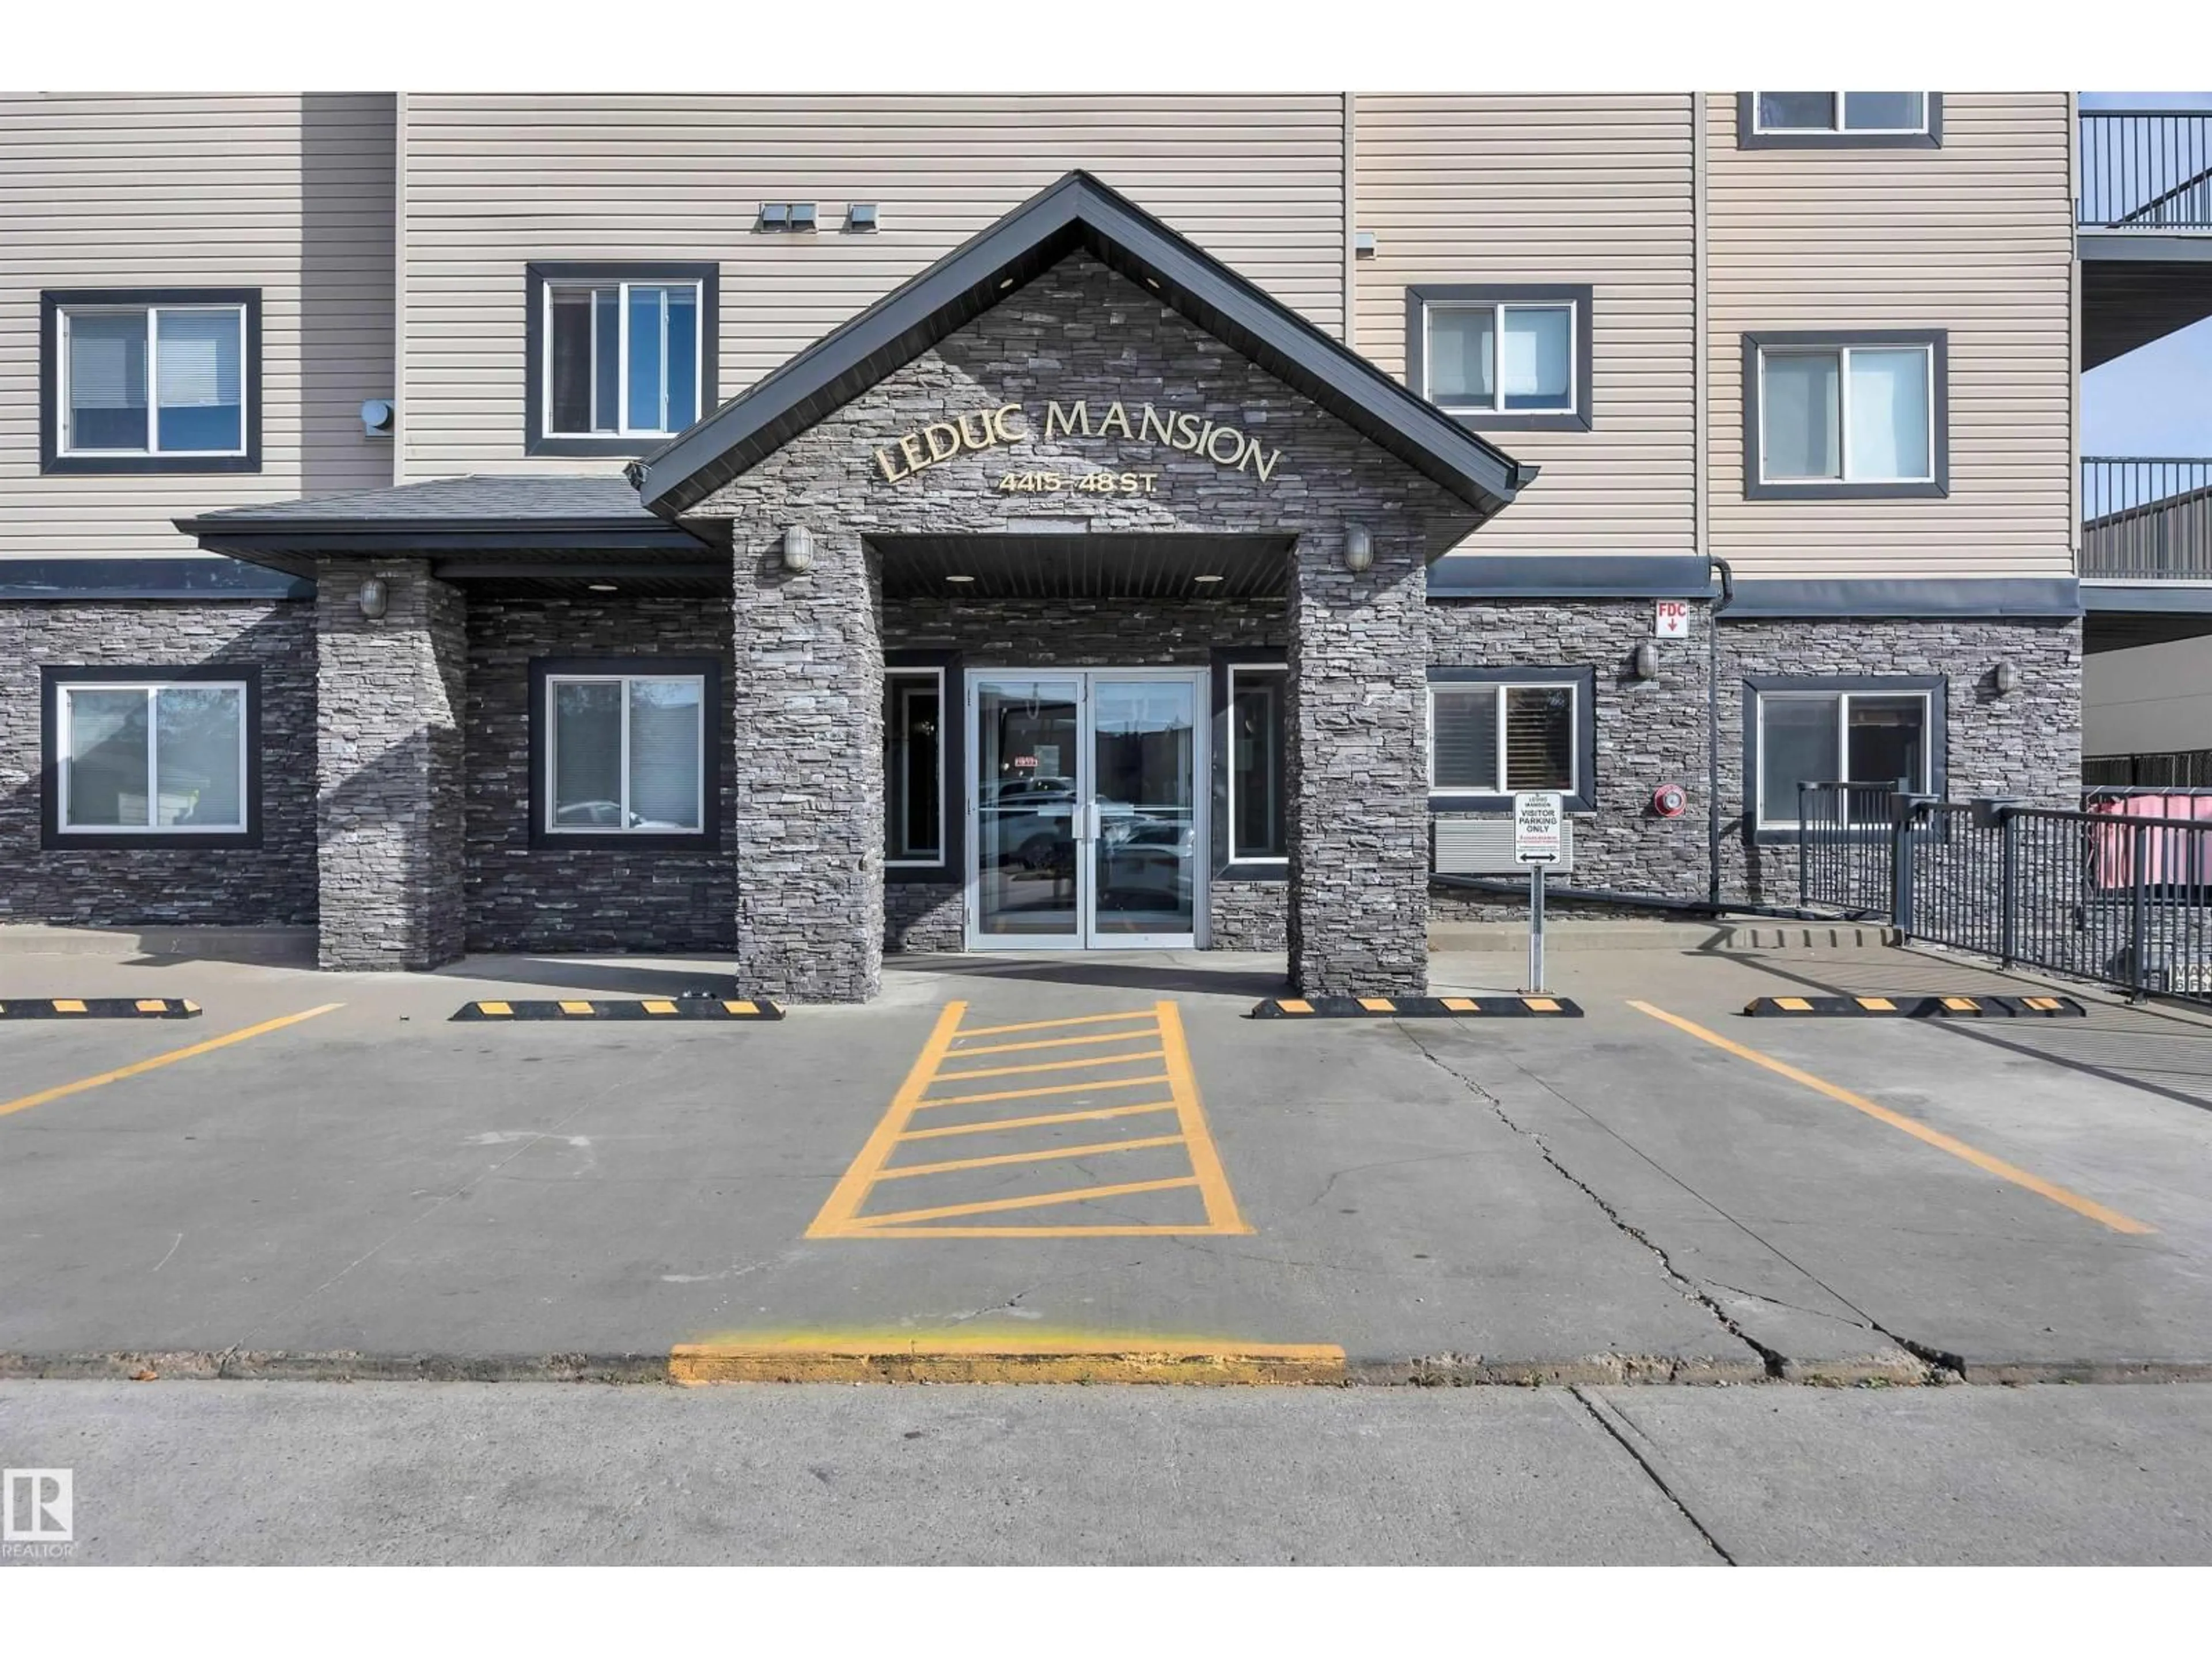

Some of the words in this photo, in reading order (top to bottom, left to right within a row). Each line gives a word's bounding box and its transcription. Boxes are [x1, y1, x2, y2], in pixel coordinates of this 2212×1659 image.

[874, 403, 1028, 484] LEDUC
[1044, 400, 1282, 484] MANSION
[1120, 472, 1158, 492] ST.
[1659, 603, 1686, 617] FDC
